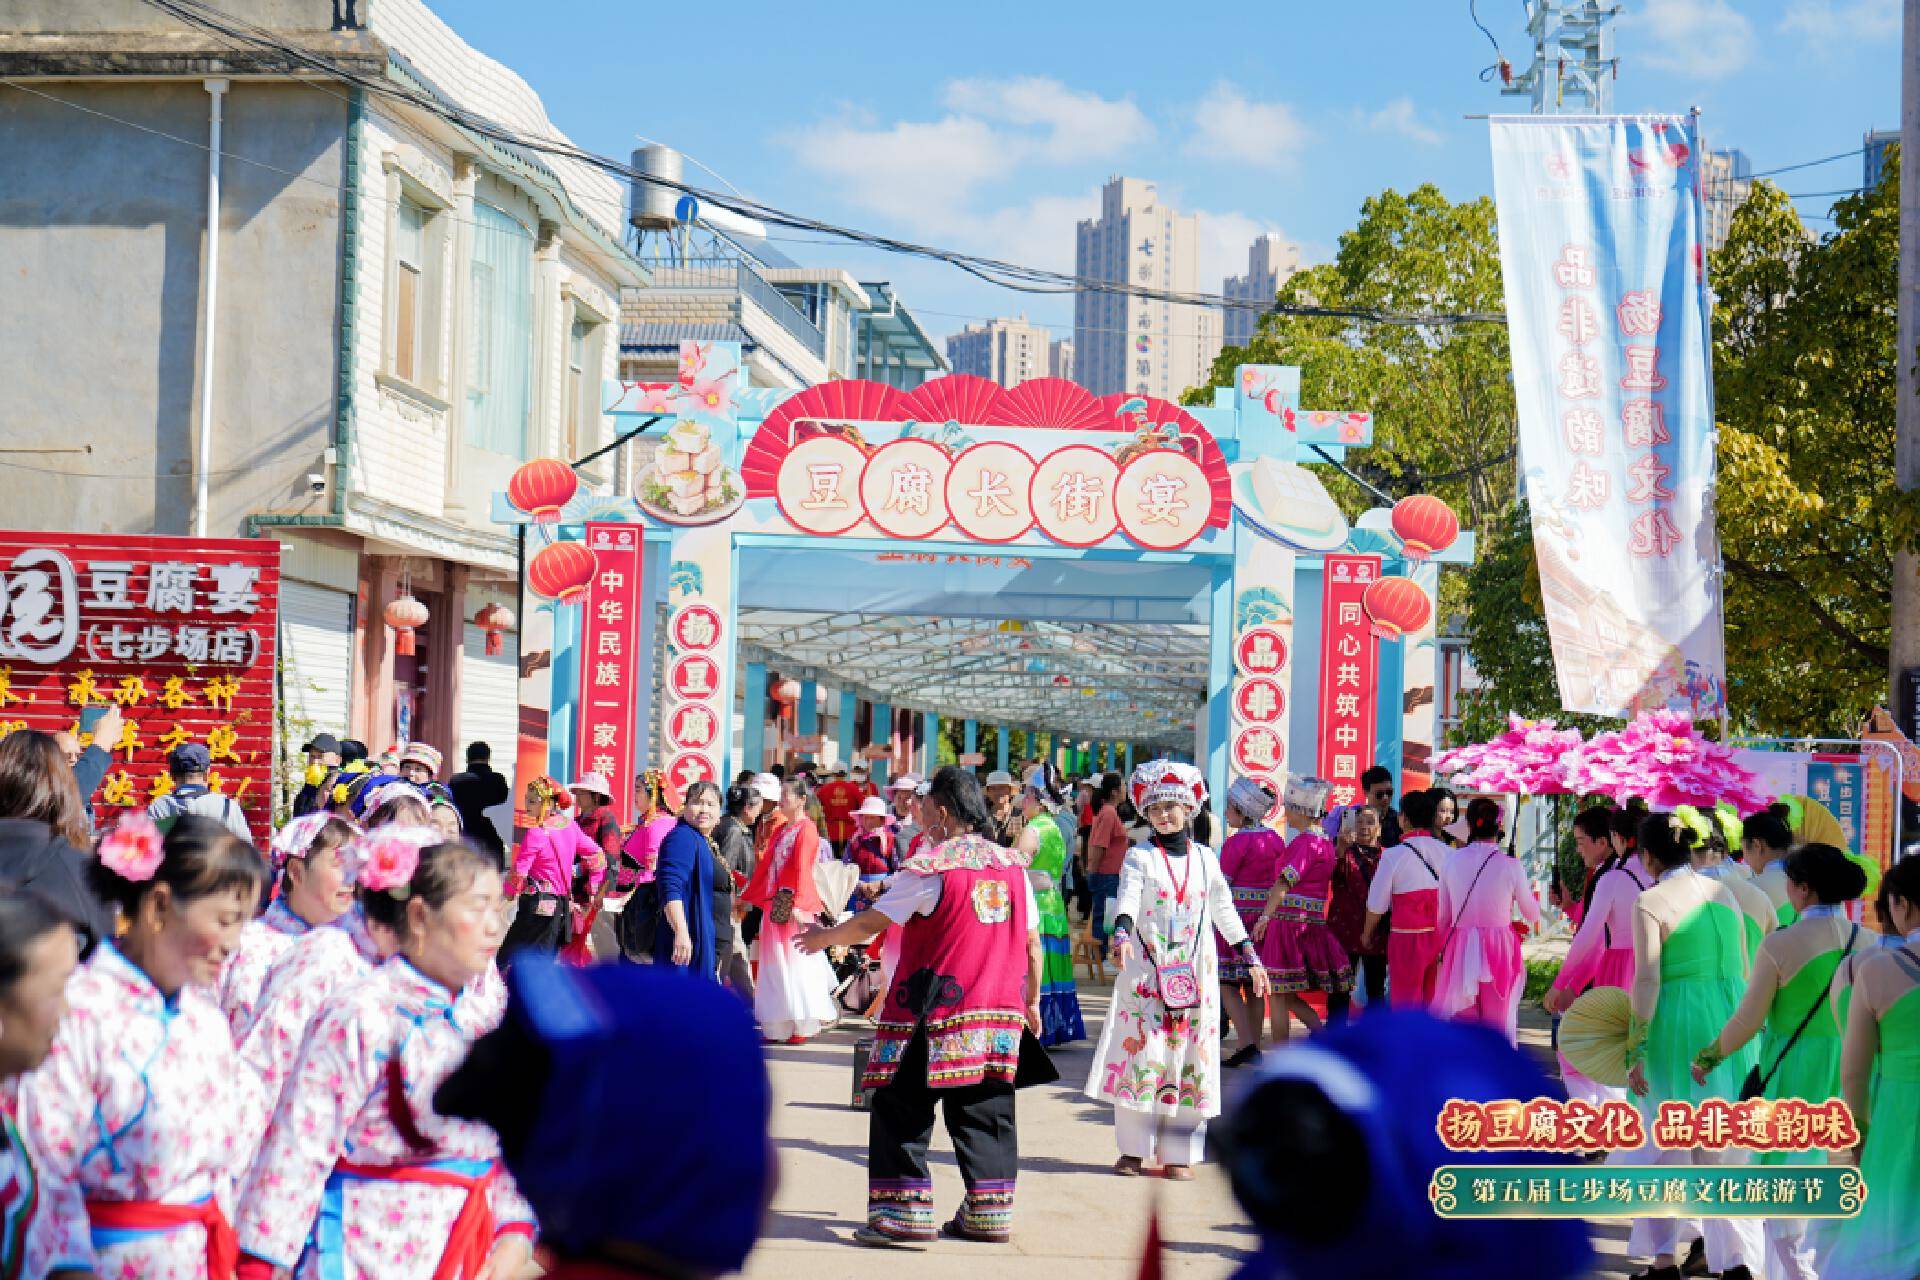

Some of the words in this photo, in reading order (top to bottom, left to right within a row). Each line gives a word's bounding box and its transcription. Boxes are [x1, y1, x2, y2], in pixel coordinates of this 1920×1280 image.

[802, 462, 1188, 527] 豆腐长街宴
[84, 561, 260, 614] 豆腐宴
[87, 624, 260, 667] (七步场店)
[592, 569, 624, 778] 中华民族一家亲
[1332, 602, 1362, 806] 同心共筑中国梦
